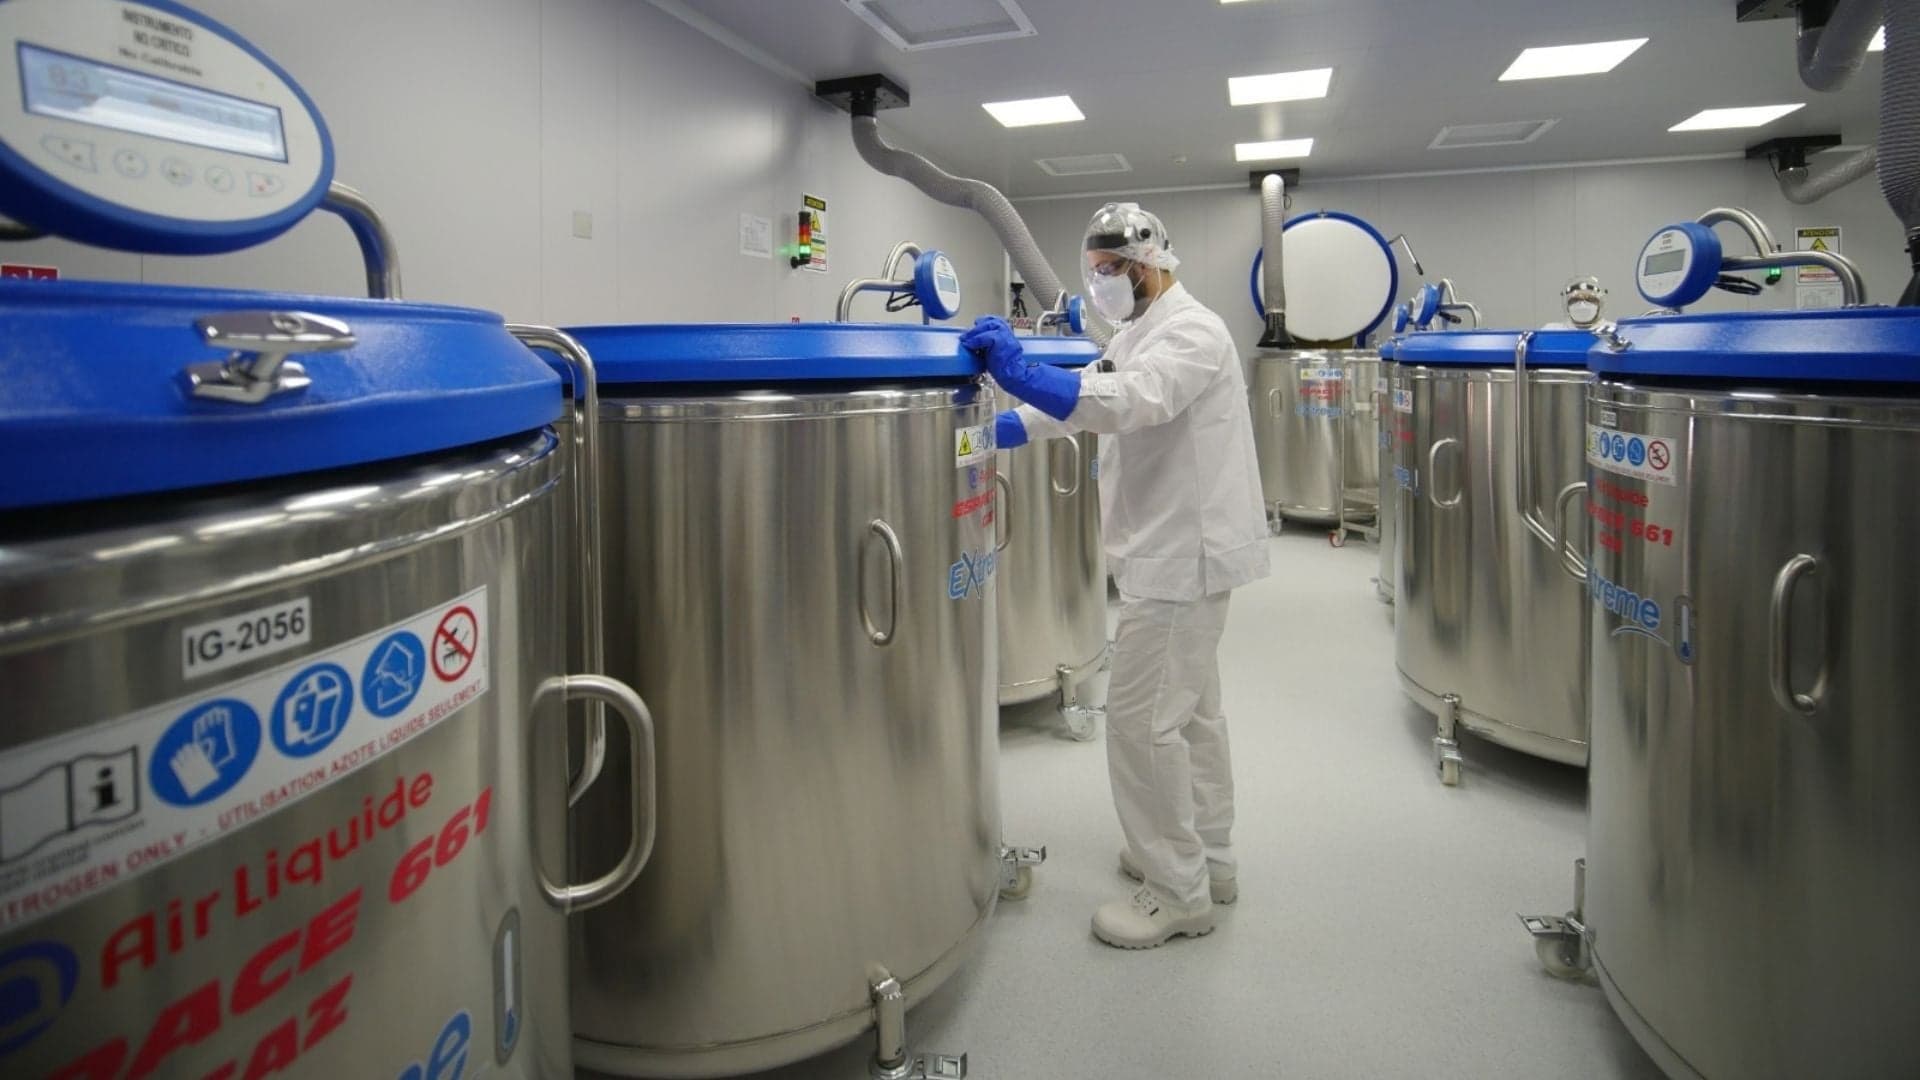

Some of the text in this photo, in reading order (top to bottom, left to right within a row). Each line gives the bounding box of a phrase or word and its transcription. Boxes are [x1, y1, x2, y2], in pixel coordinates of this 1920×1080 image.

[1630, 518, 1673, 547] 661
[185, 606, 306, 667] IG-2056
[126, 830, 189, 872] ONLY
[218, 766, 326, 829] UTILISATION
[331, 741, 377, 775] AZOTE
[379, 713, 426, 750] LIQUIDE
[388, 785, 493, 904] 661
[102, 890, 220, 992] Air
[234, 772, 434, 918] Liquide
